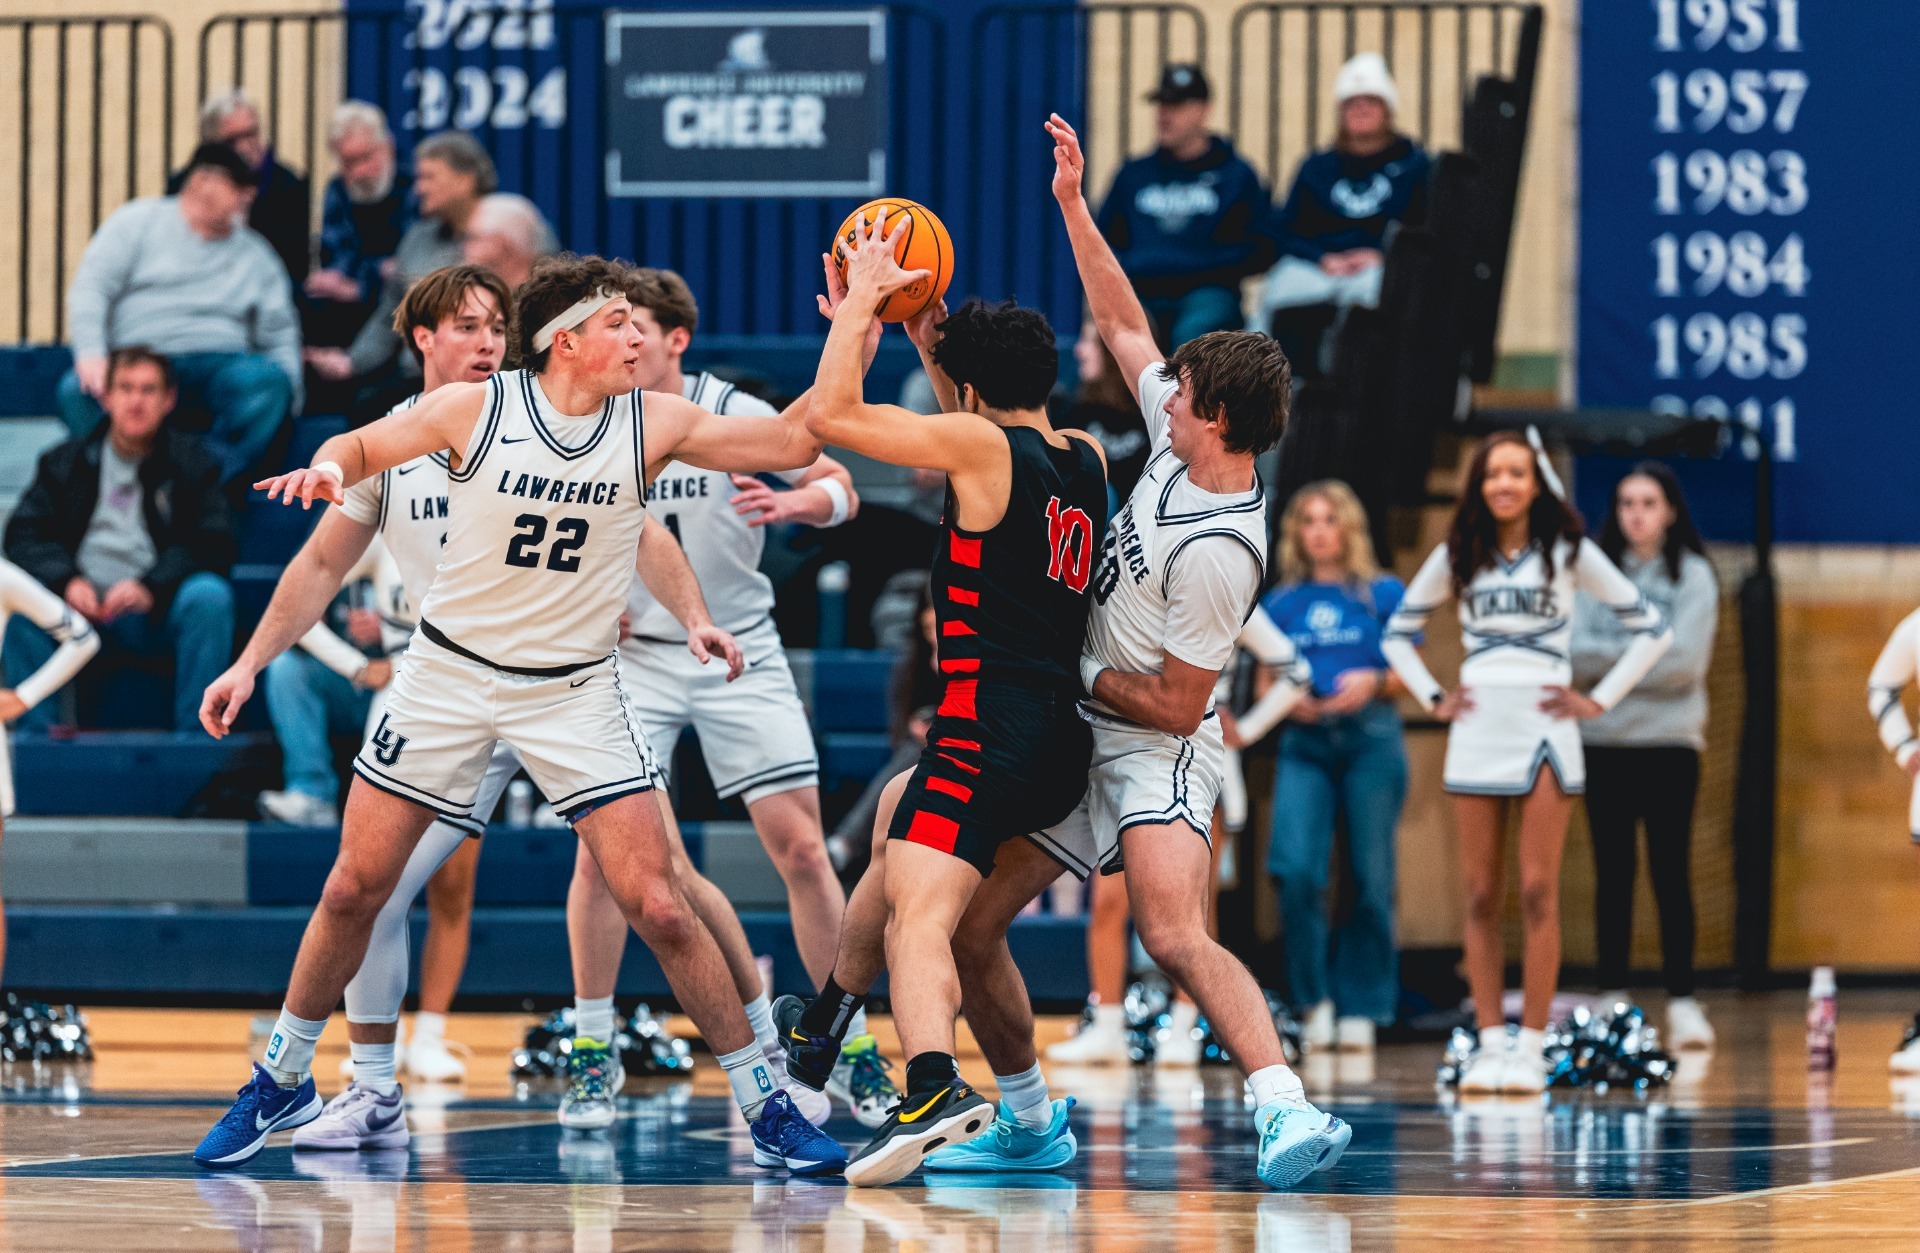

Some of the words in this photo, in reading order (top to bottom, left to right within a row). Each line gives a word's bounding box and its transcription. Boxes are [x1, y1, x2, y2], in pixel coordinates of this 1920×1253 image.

[1652, 0, 1801, 52] 1951
[663, 94, 828, 148] CHEER
[1650, 69, 1810, 133] 1957
[1650, 149, 1809, 215] 1983
[1650, 230, 1811, 297] 1984
[1650, 311, 1808, 379] 1985
[497, 470, 620, 506] LAWRENCE
[505, 513, 590, 573] 22
[1045, 495, 1092, 594] 10
